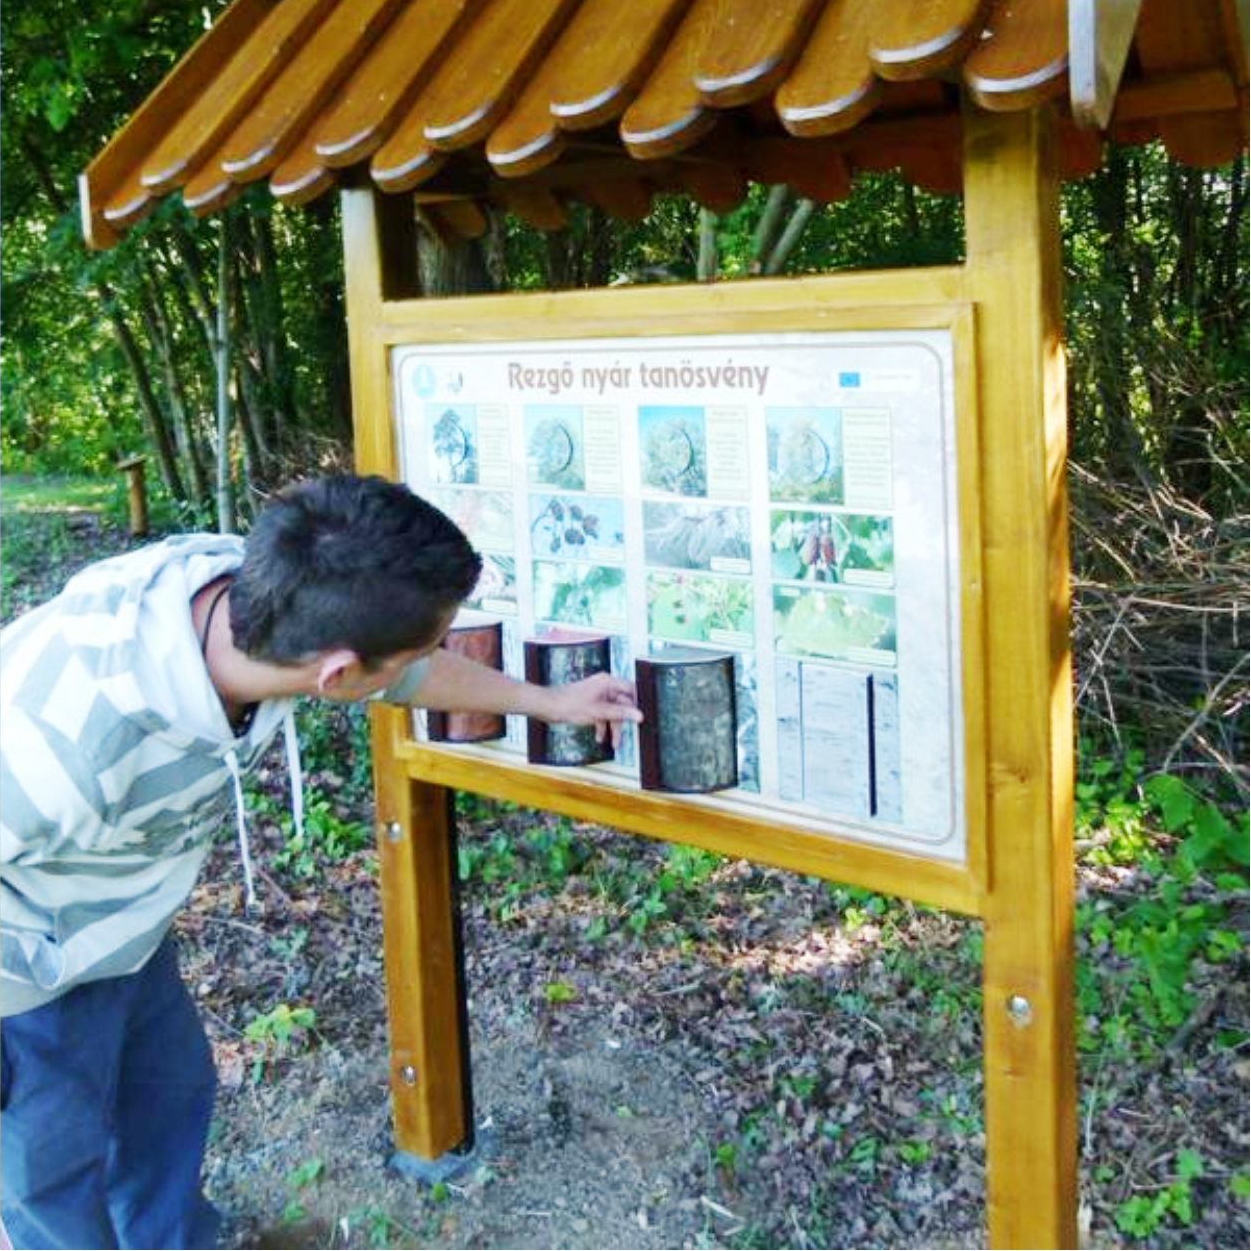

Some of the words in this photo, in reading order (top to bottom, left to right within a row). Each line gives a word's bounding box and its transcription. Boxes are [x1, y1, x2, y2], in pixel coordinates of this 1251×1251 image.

[507, 361, 574, 395] Rezgő
[581, 361, 631, 395] nyár
[639, 360, 770, 396] tanösvény
